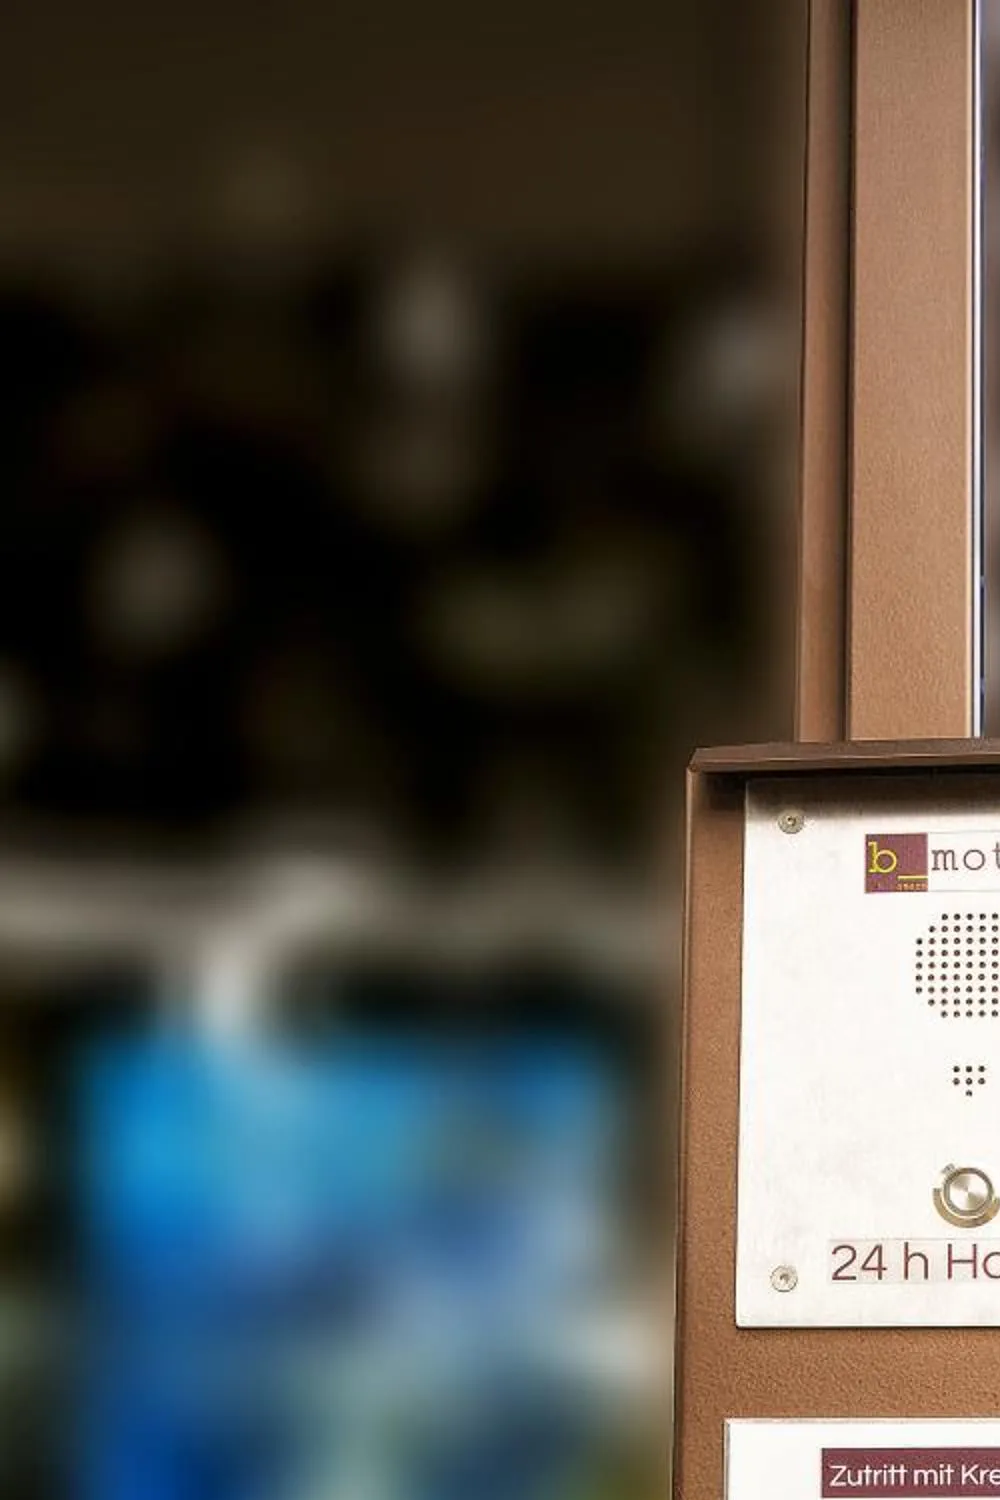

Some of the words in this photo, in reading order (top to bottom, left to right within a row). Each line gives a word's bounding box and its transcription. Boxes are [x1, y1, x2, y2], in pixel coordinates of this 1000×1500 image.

[831, 1244, 887, 1280] 24
[903, 1241, 929, 1280] h
[829, 1464, 907, 1487] Zutritt
[914, 1464, 954, 1486] mit
